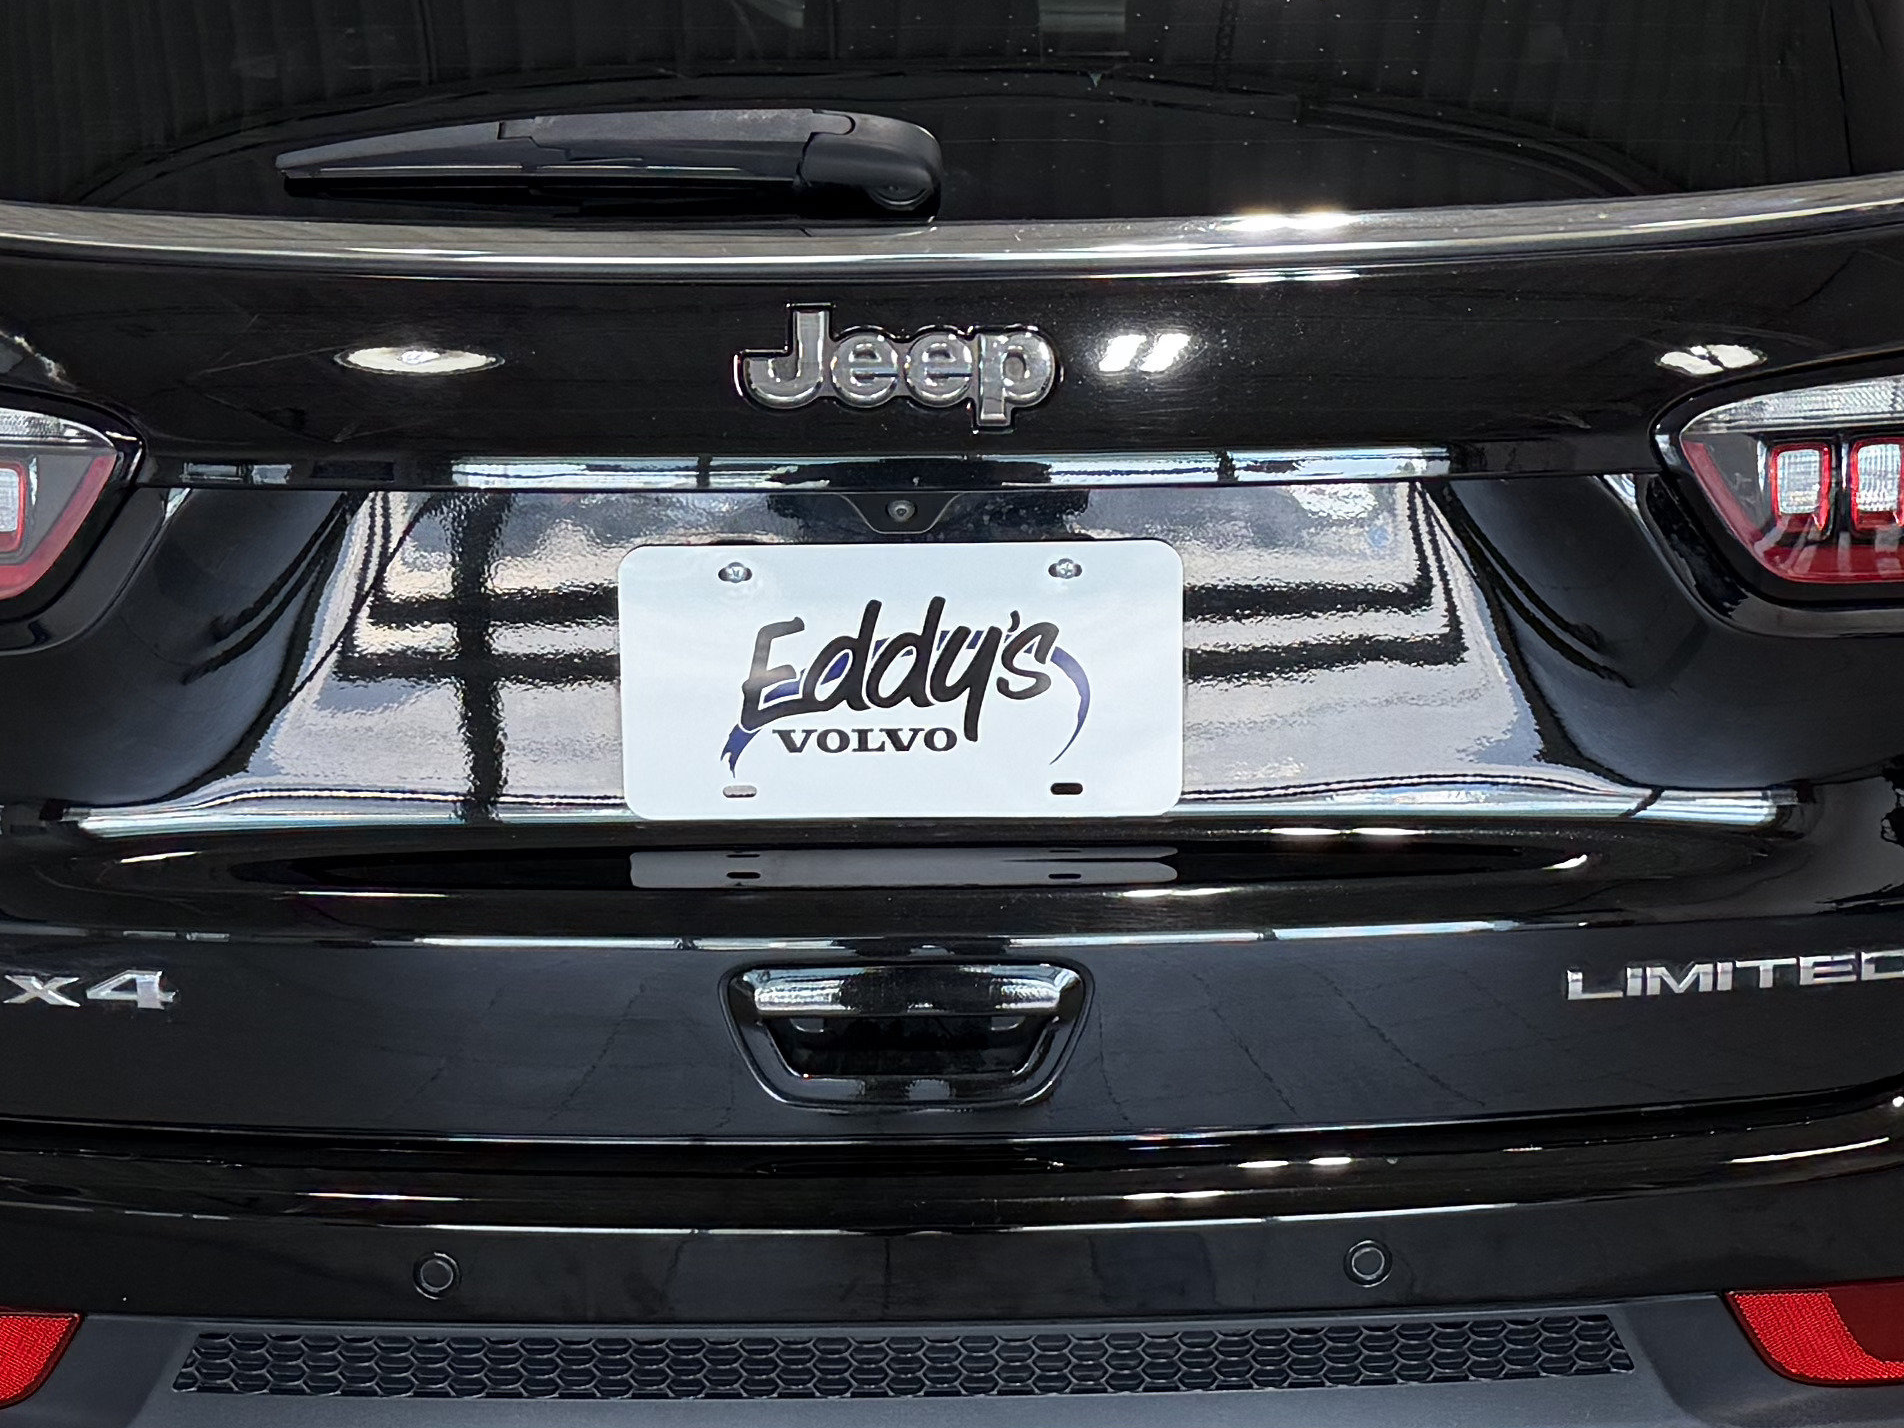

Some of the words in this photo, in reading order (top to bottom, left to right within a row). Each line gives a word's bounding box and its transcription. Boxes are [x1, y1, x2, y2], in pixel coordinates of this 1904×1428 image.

[737, 304, 1061, 432] Jeep
[741, 596, 1060, 742] Eddy's
[772, 727, 959, 753] VOLVO
